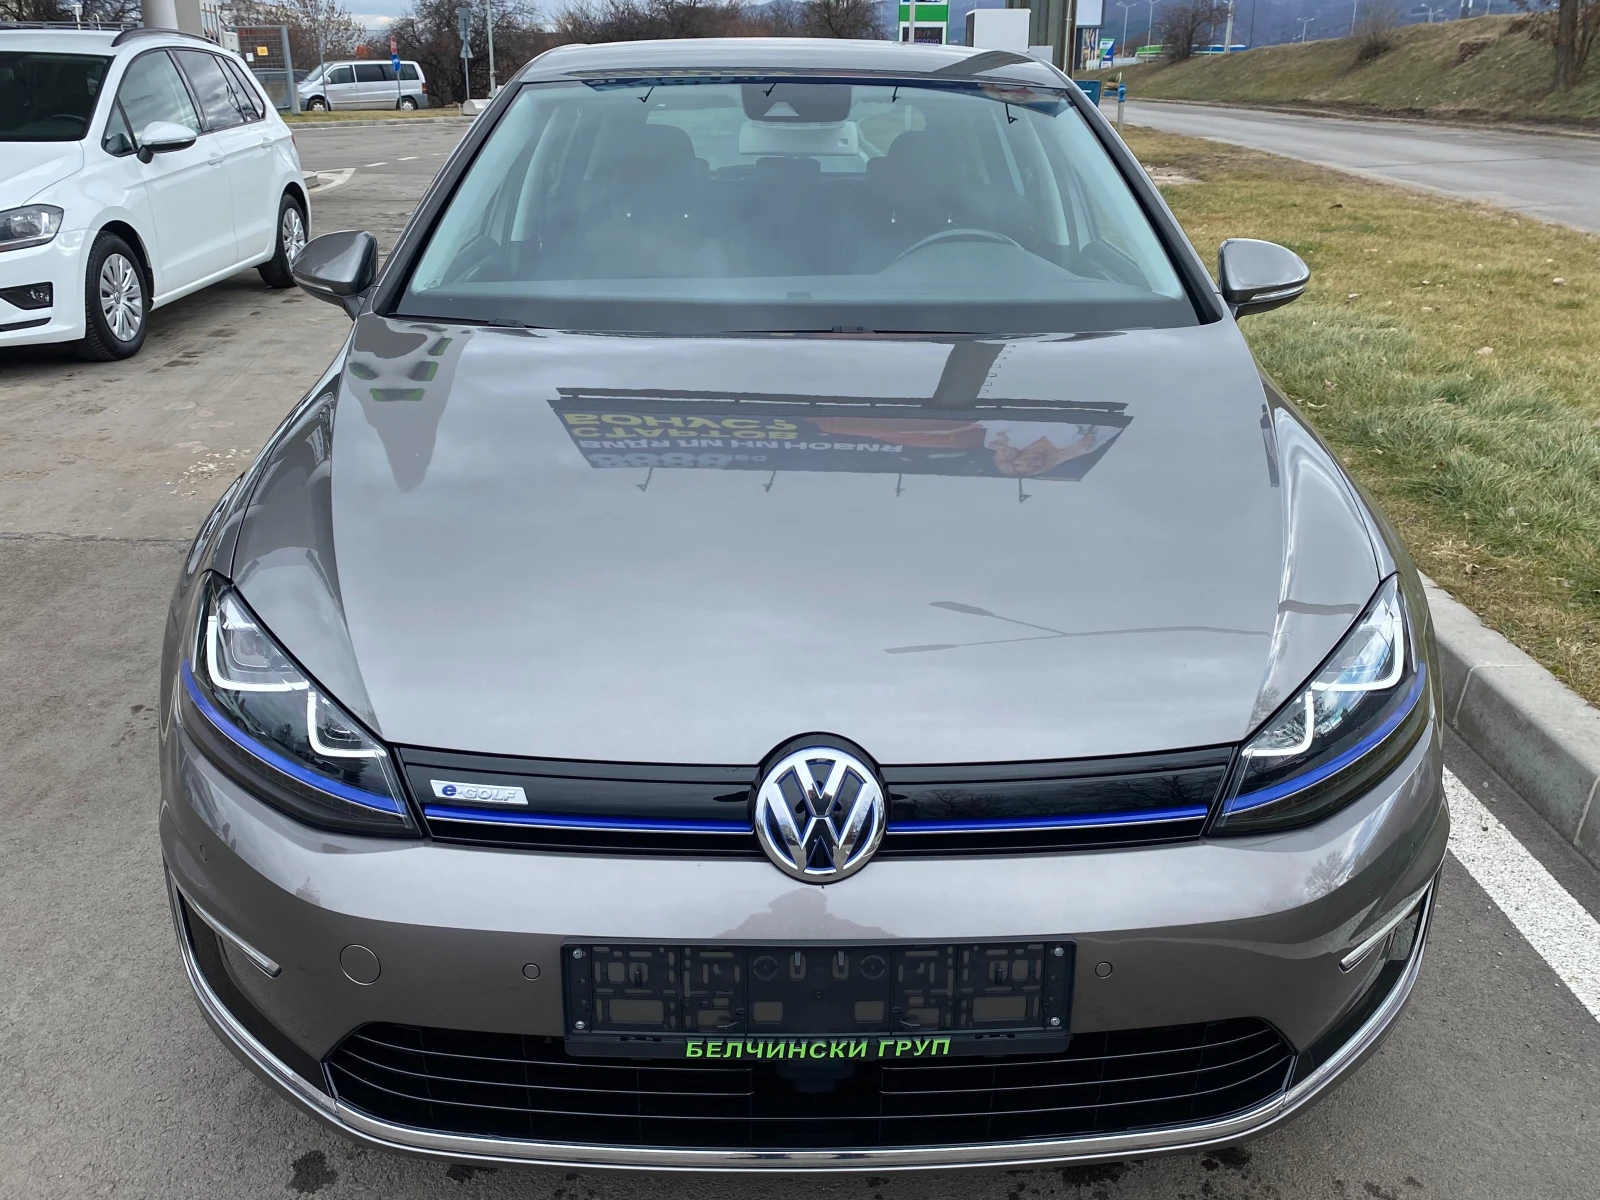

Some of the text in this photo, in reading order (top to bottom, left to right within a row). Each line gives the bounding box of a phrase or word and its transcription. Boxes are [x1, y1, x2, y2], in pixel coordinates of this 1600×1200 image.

[441, 784, 517, 802] e-GOLF
[756, 746, 885, 883] VW
[685, 1038, 951, 1059] БЕЛЧИНСКИ ГРУП
